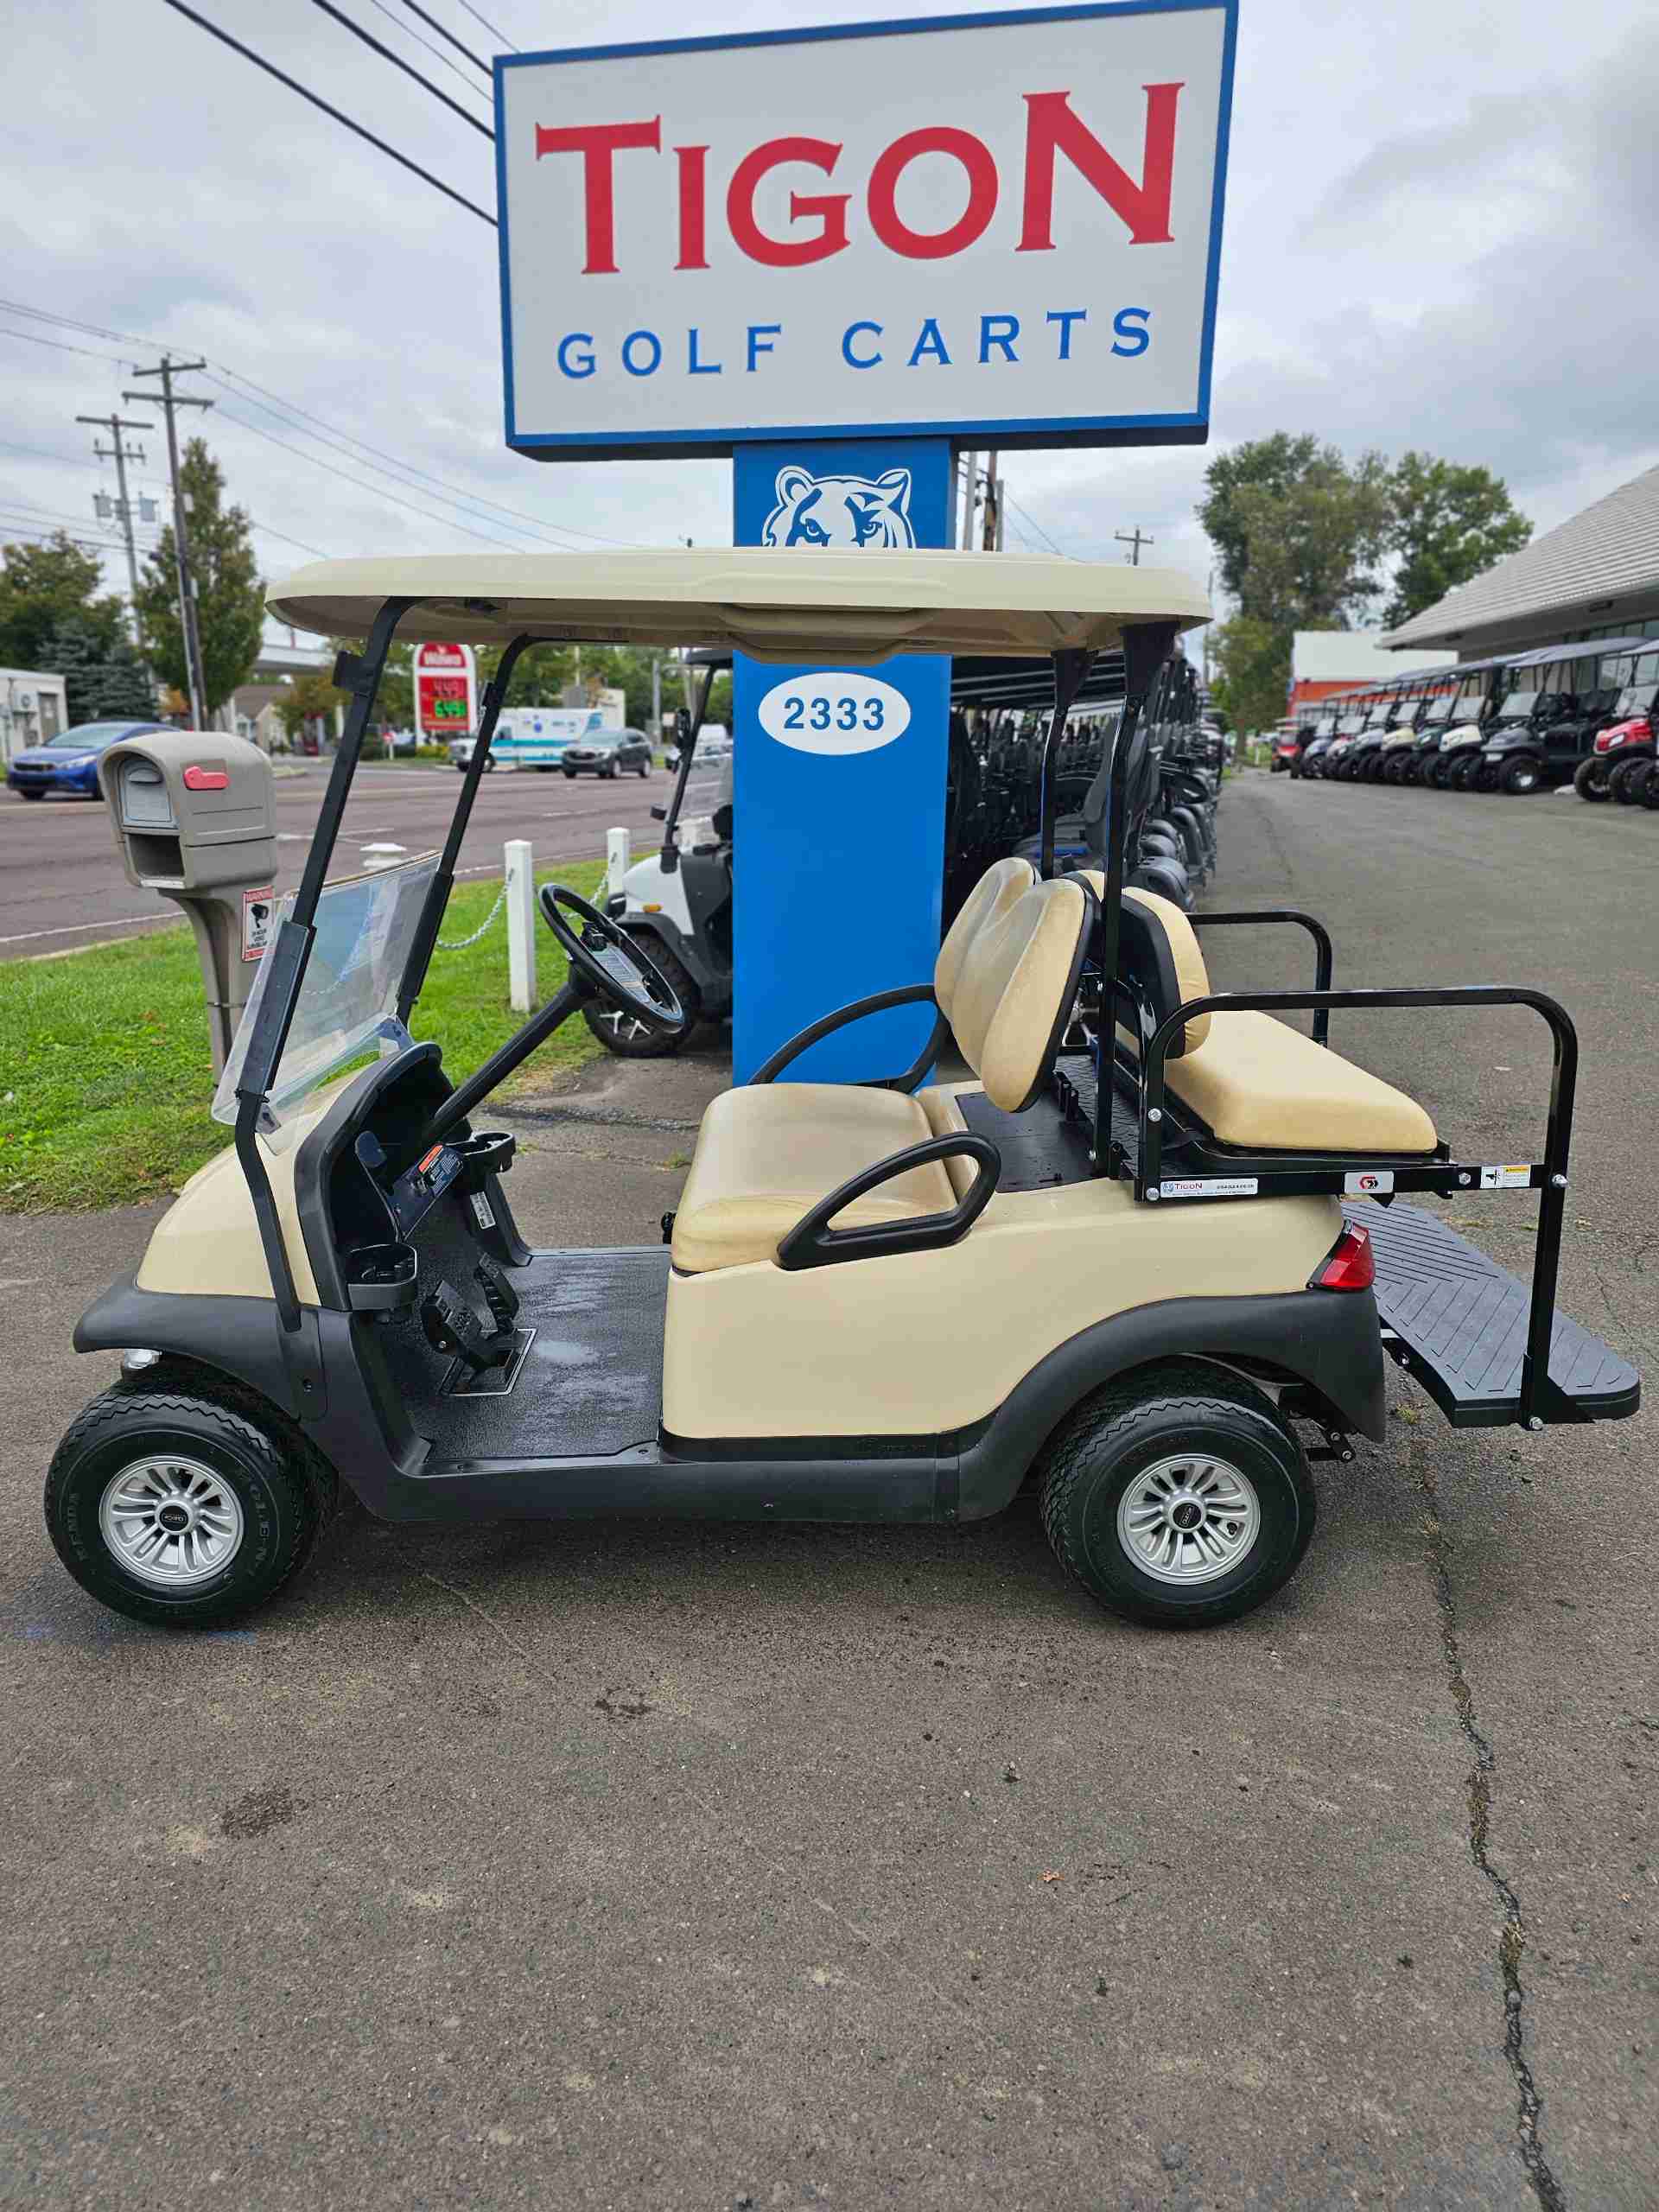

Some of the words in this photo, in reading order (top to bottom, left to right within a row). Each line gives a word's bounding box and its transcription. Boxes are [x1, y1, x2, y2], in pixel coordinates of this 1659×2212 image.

[535, 82, 1185, 274] TIGON
[557, 323, 783, 379] GOLF
[842, 307, 1153, 370] CARTS
[783, 696, 885, 731] 2333
